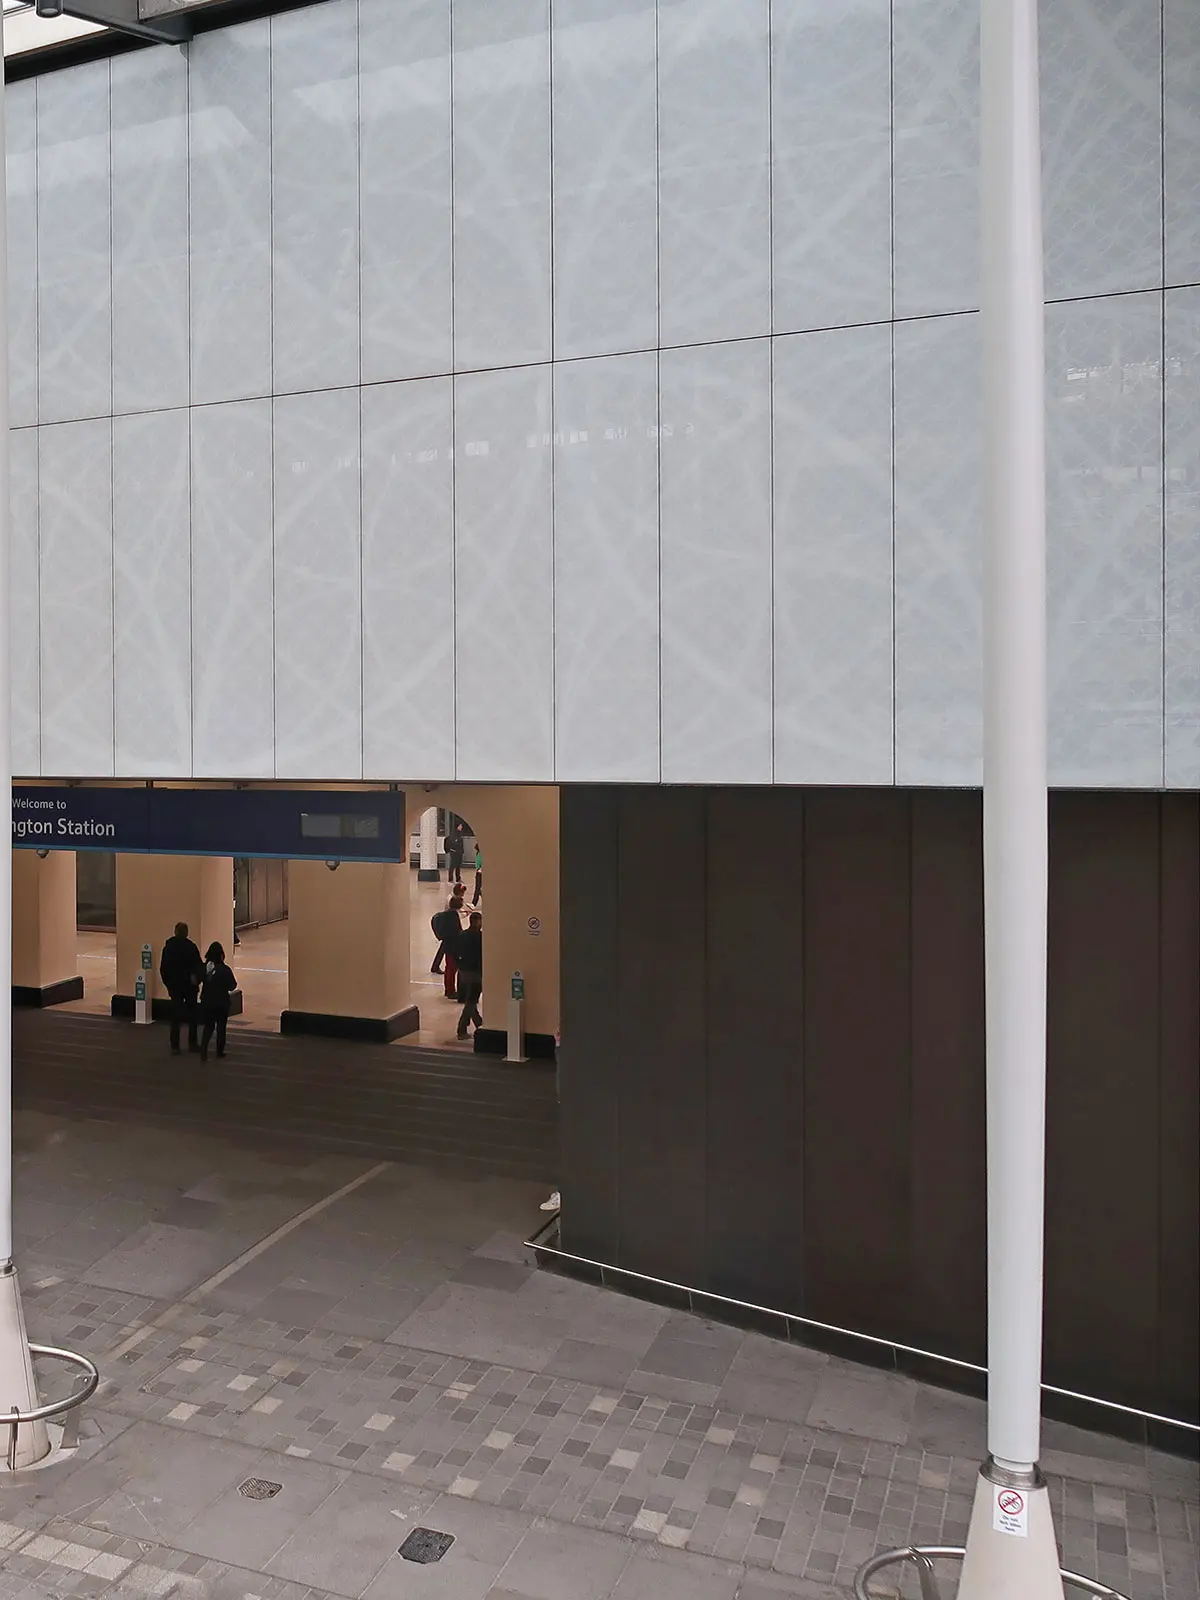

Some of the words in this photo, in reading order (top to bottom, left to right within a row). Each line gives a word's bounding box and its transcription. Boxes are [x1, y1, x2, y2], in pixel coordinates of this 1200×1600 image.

[12, 798, 54, 810] Welcome
[56, 800, 67, 810] to
[57, 817, 115, 837] Station
